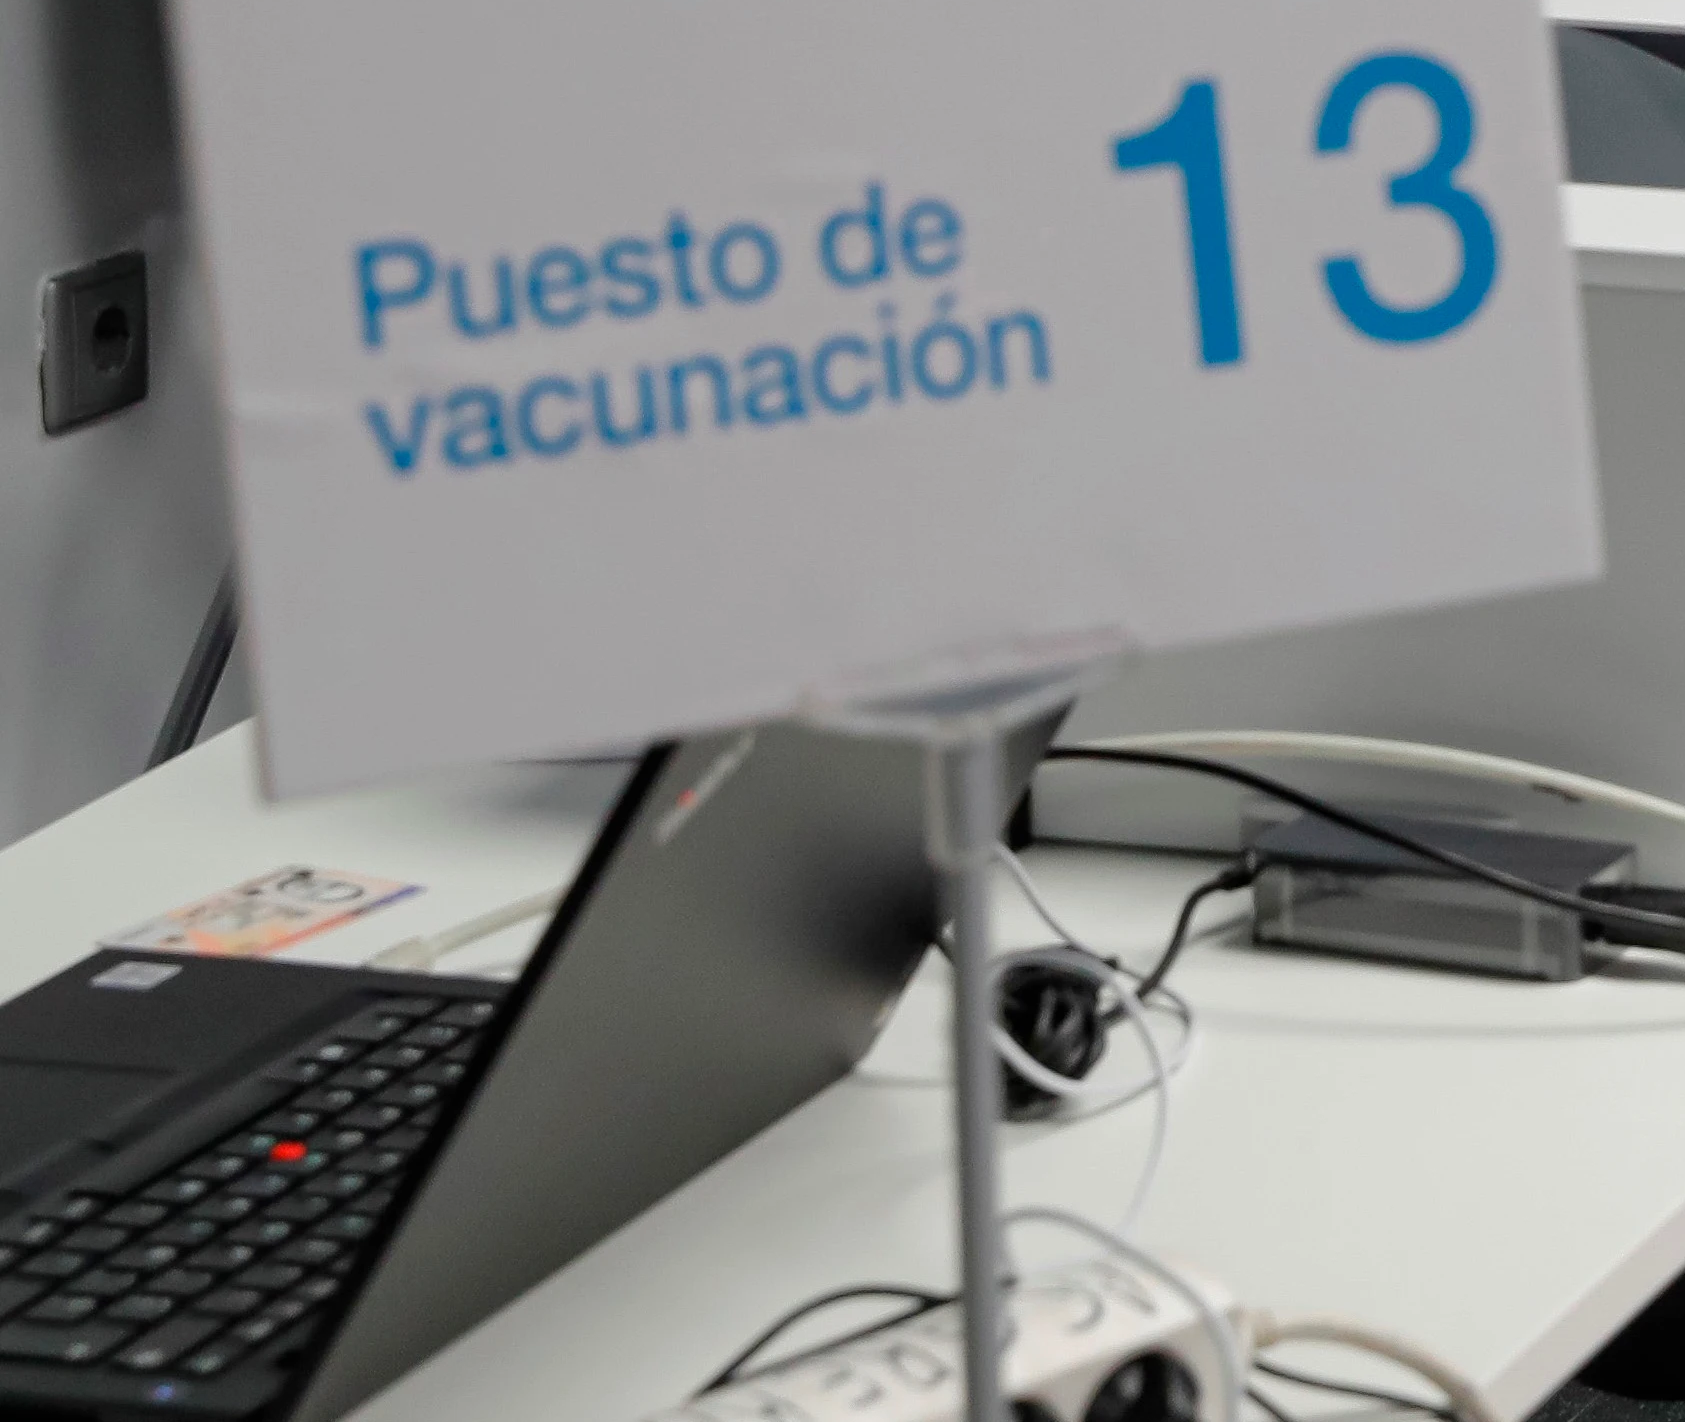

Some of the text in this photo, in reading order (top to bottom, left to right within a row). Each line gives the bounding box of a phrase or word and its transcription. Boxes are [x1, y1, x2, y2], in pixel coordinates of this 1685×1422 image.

[354, 180, 964, 352] Puesto de
[1112, 51, 1500, 368] 13
[363, 289, 1052, 480] vacunación
